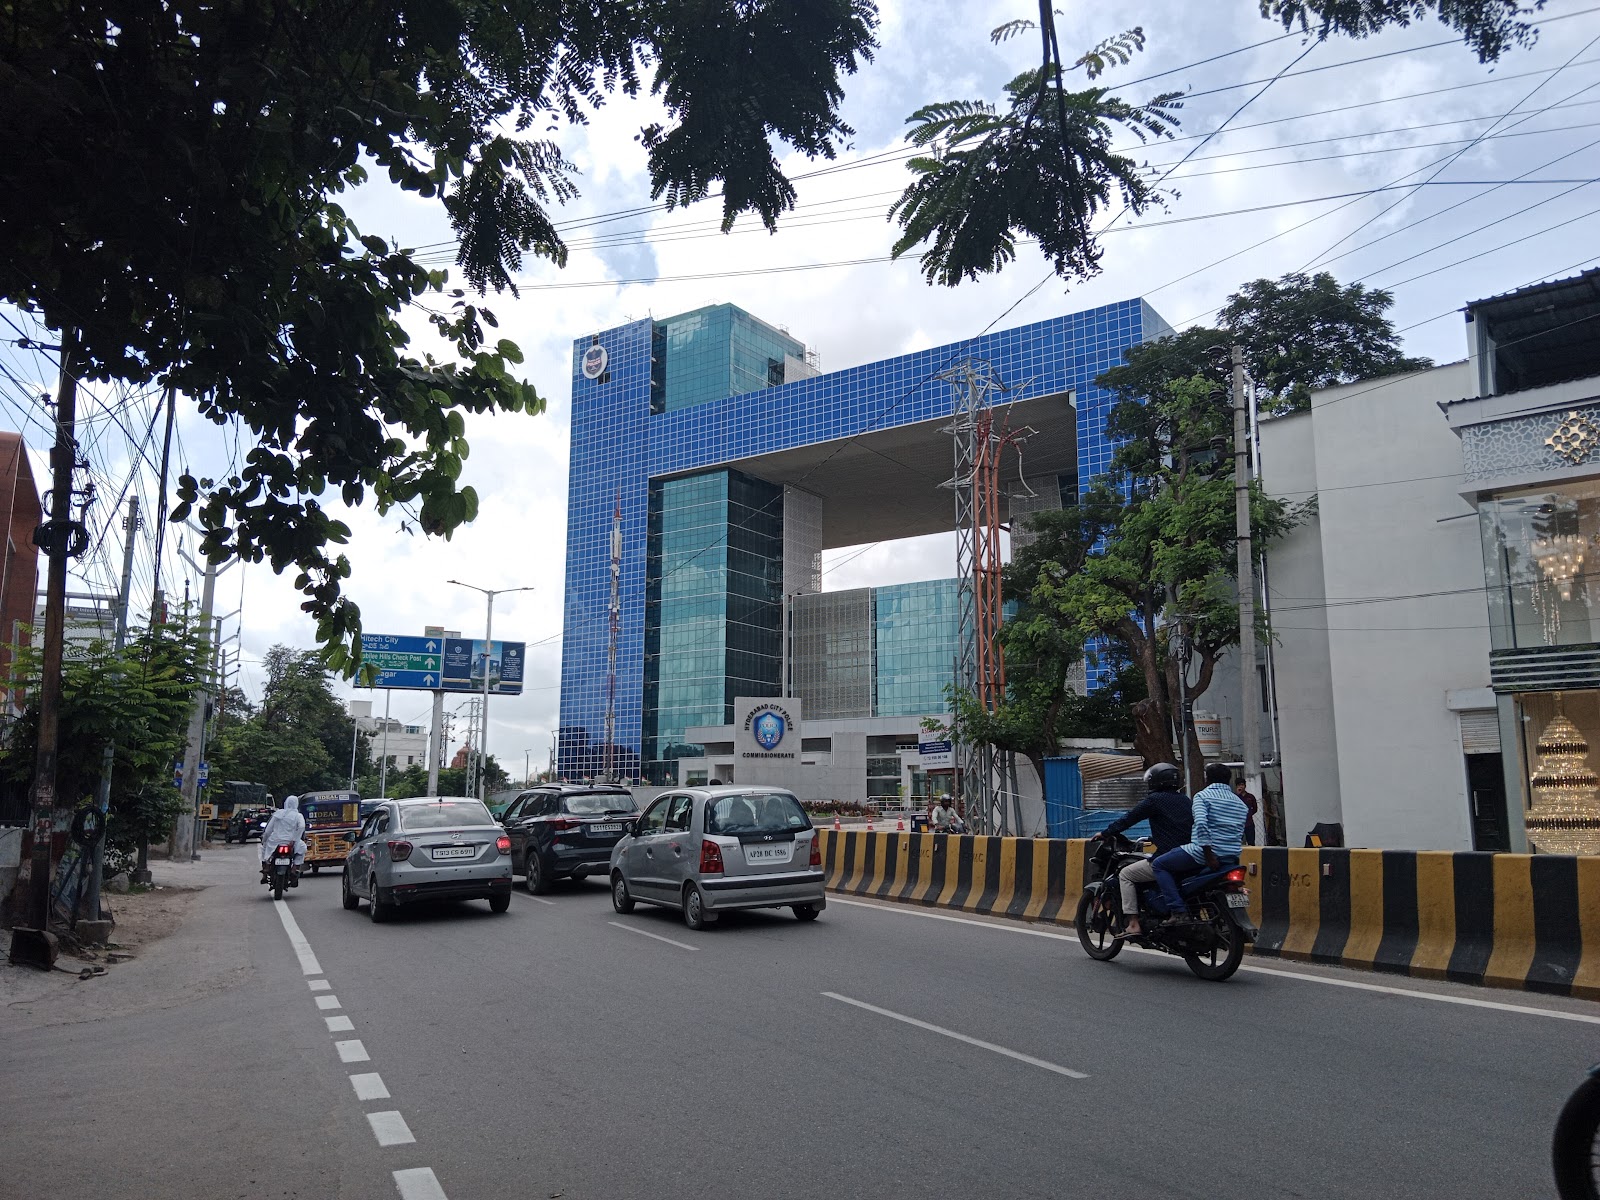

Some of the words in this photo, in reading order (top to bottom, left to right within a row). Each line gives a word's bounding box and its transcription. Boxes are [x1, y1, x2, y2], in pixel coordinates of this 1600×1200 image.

[361, 634, 382, 642] Hitech
[385, 636, 399, 644] City
[744, 704, 769, 731] HYDERABAD
[770, 704, 783, 712] CITY
[782, 710, 793, 731] POLICE
